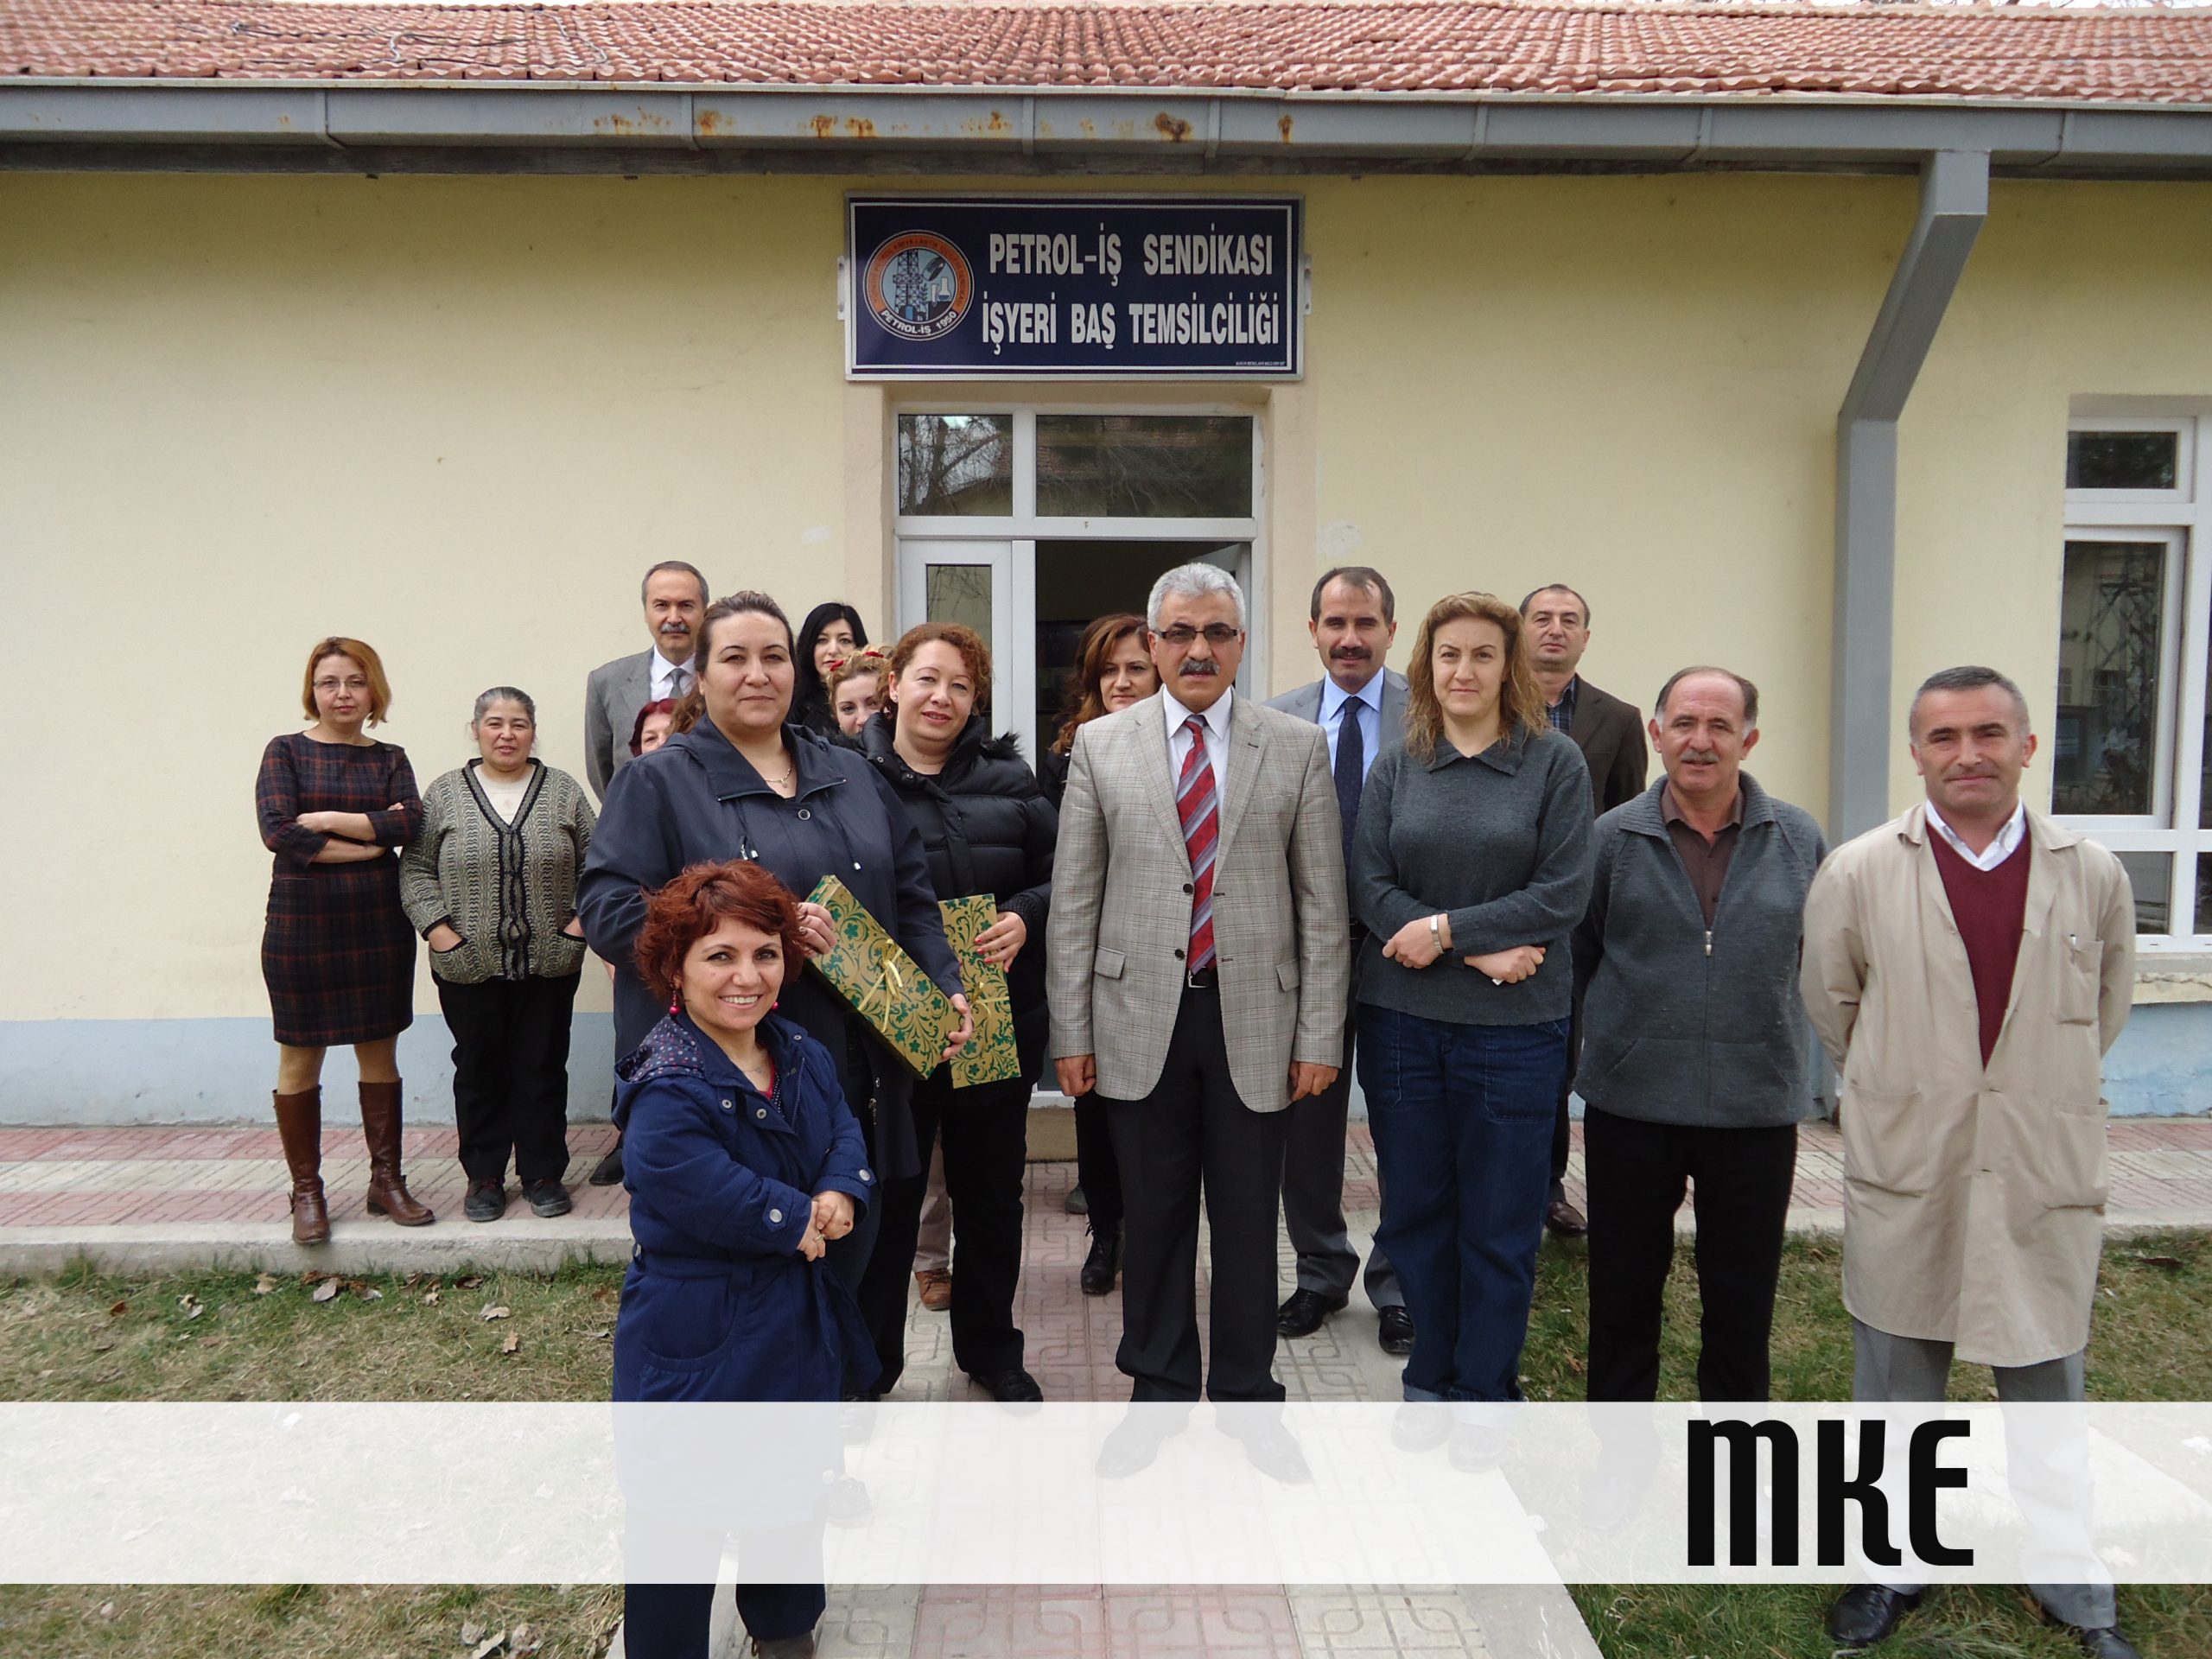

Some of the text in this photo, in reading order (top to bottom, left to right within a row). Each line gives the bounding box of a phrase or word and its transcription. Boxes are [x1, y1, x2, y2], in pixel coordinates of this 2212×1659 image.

[989, 222, 1122, 287] PETROL-İŞ
[1143, 222, 1273, 276] SENDİKASI
[936, 311, 957, 329] 1950
[982, 290, 1280, 355] İŞYERİ BAŞ TEMSİLCİLİĞİ
